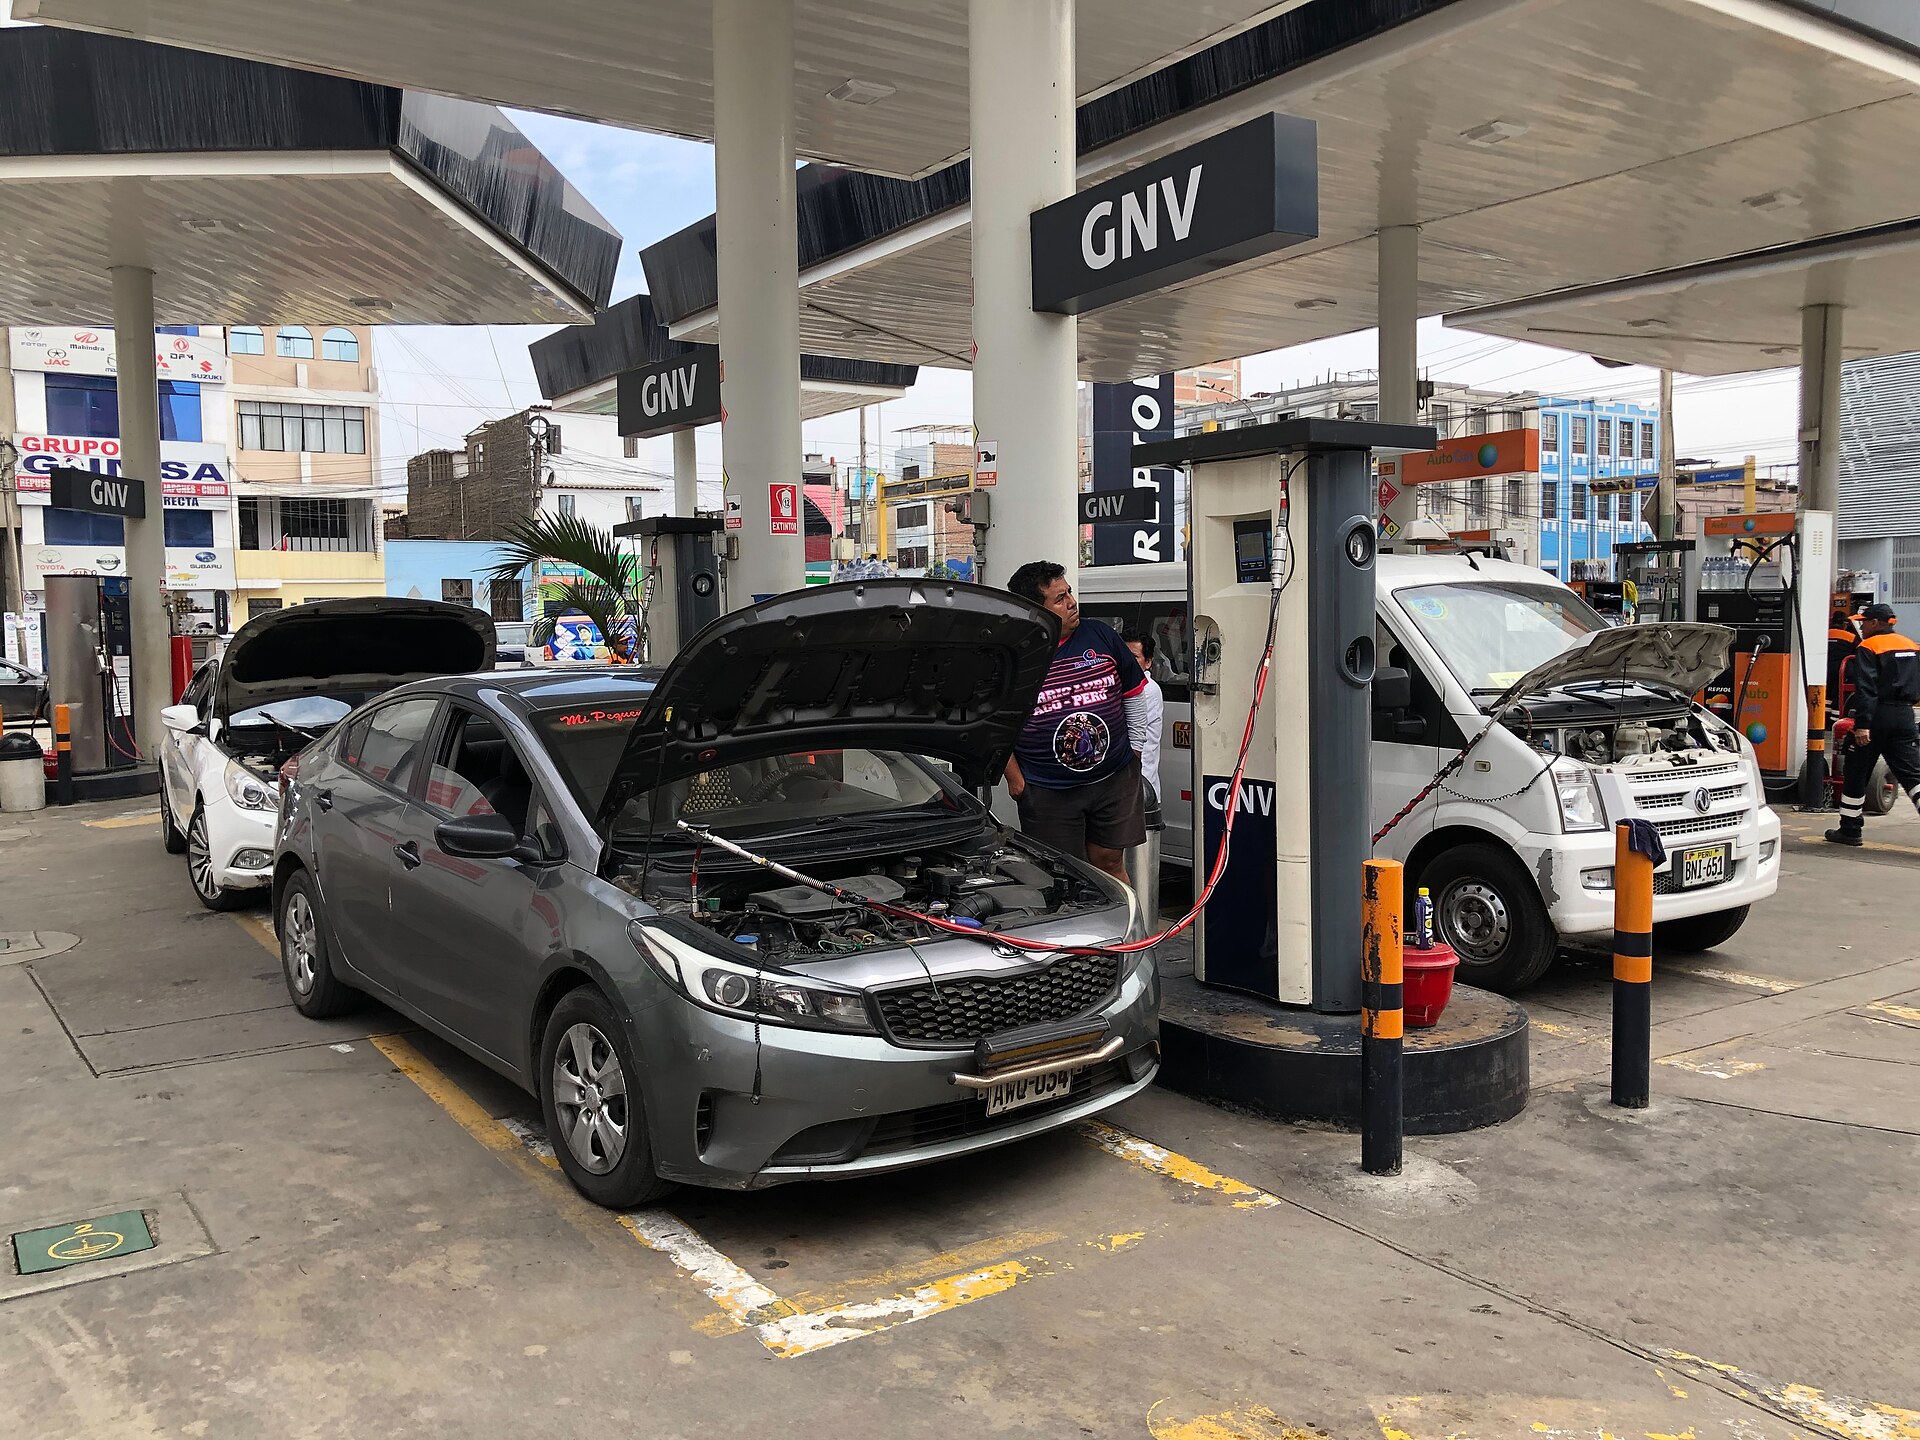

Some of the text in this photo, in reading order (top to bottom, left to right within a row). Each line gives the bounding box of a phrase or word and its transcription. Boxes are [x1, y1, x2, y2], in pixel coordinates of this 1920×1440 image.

[1081, 163, 1203, 270] GNV
[44, 358, 71, 366] JAC
[641, 363, 698, 417] GNV
[21, 436, 119, 456] GRUPO
[90, 479, 129, 508] GNV
[201, 485, 225, 495] CHINO
[1085, 494, 1125, 518] GNV
[772, 522, 797, 531] EXTINTOR
[560, 714, 590, 725] Mi
[1208, 782, 1273, 817] GNV
[1697, 851, 1713, 859] PERU
[1685, 856, 1722, 881] BNI-651
